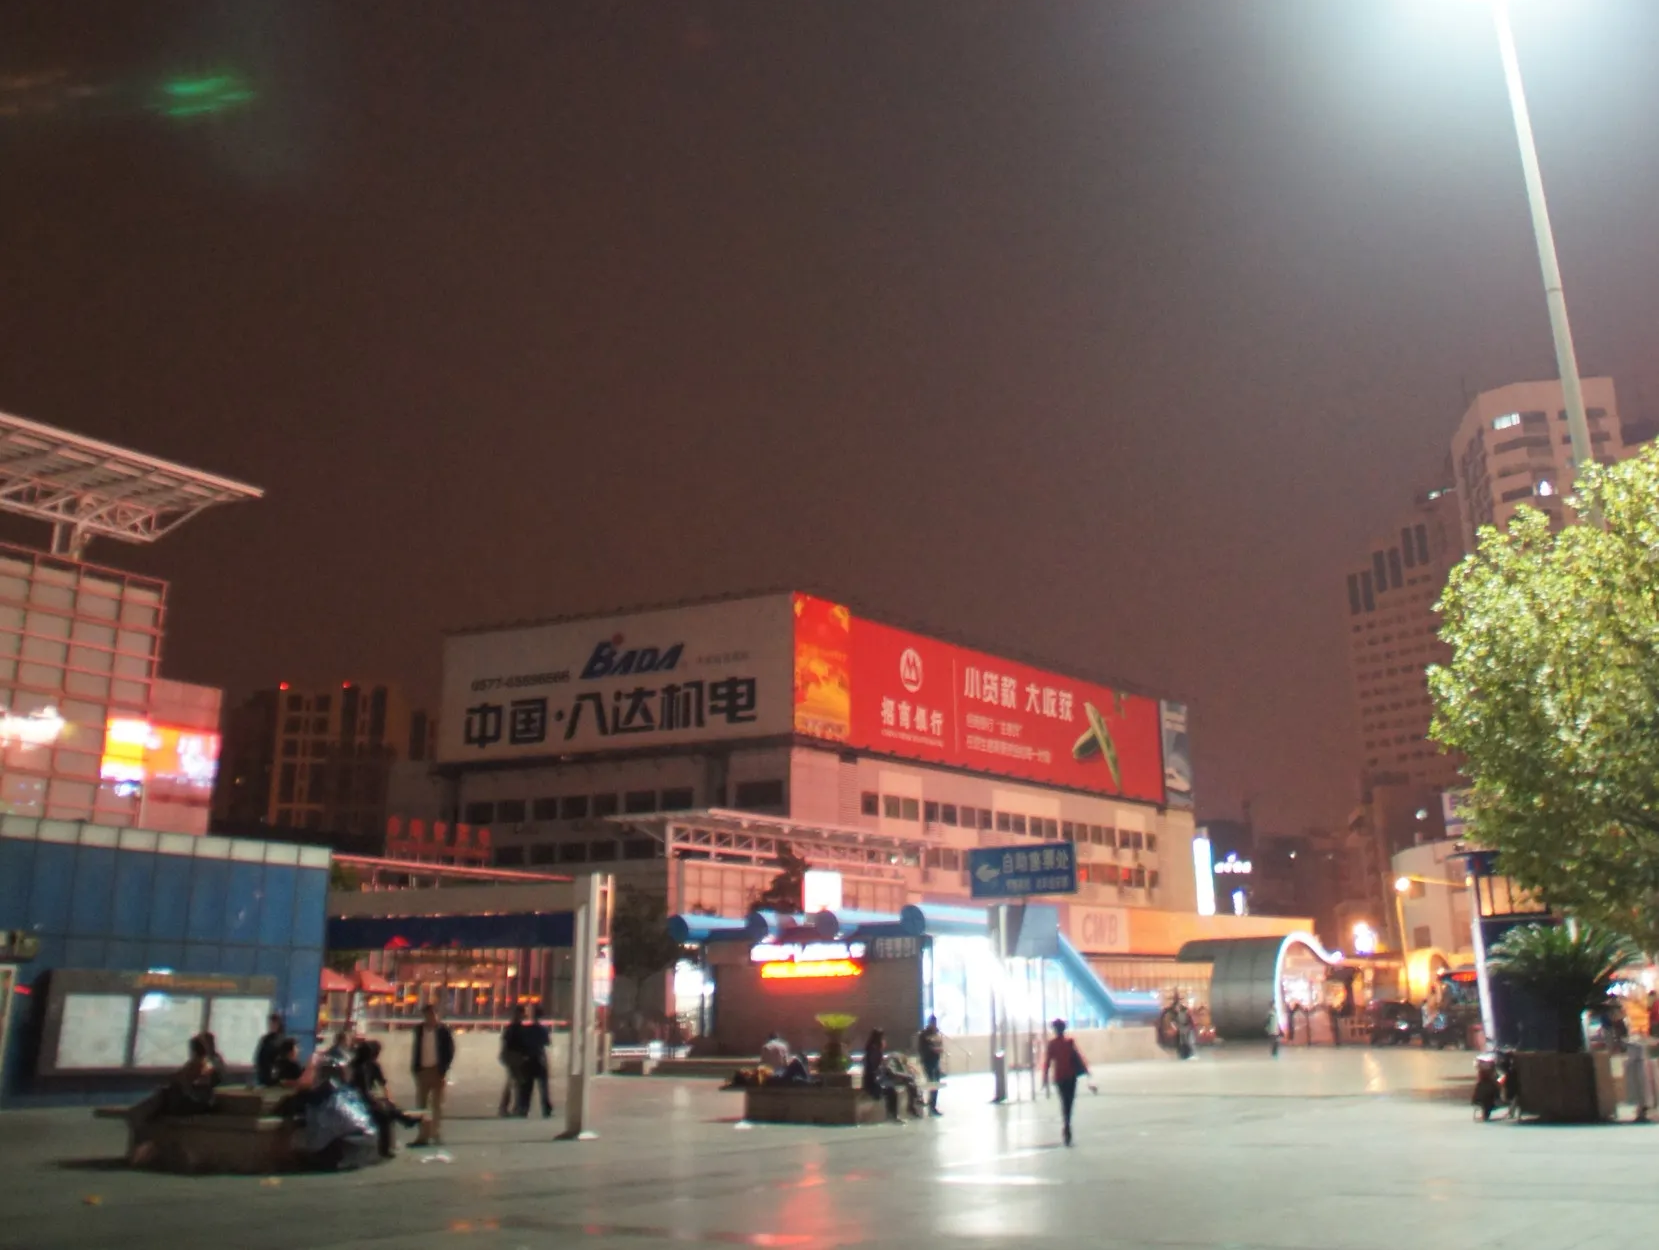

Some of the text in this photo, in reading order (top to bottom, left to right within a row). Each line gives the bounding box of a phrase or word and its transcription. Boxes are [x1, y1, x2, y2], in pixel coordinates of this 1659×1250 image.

[579, 636, 684, 679] BADA
[881, 696, 943, 736] 招商银行
